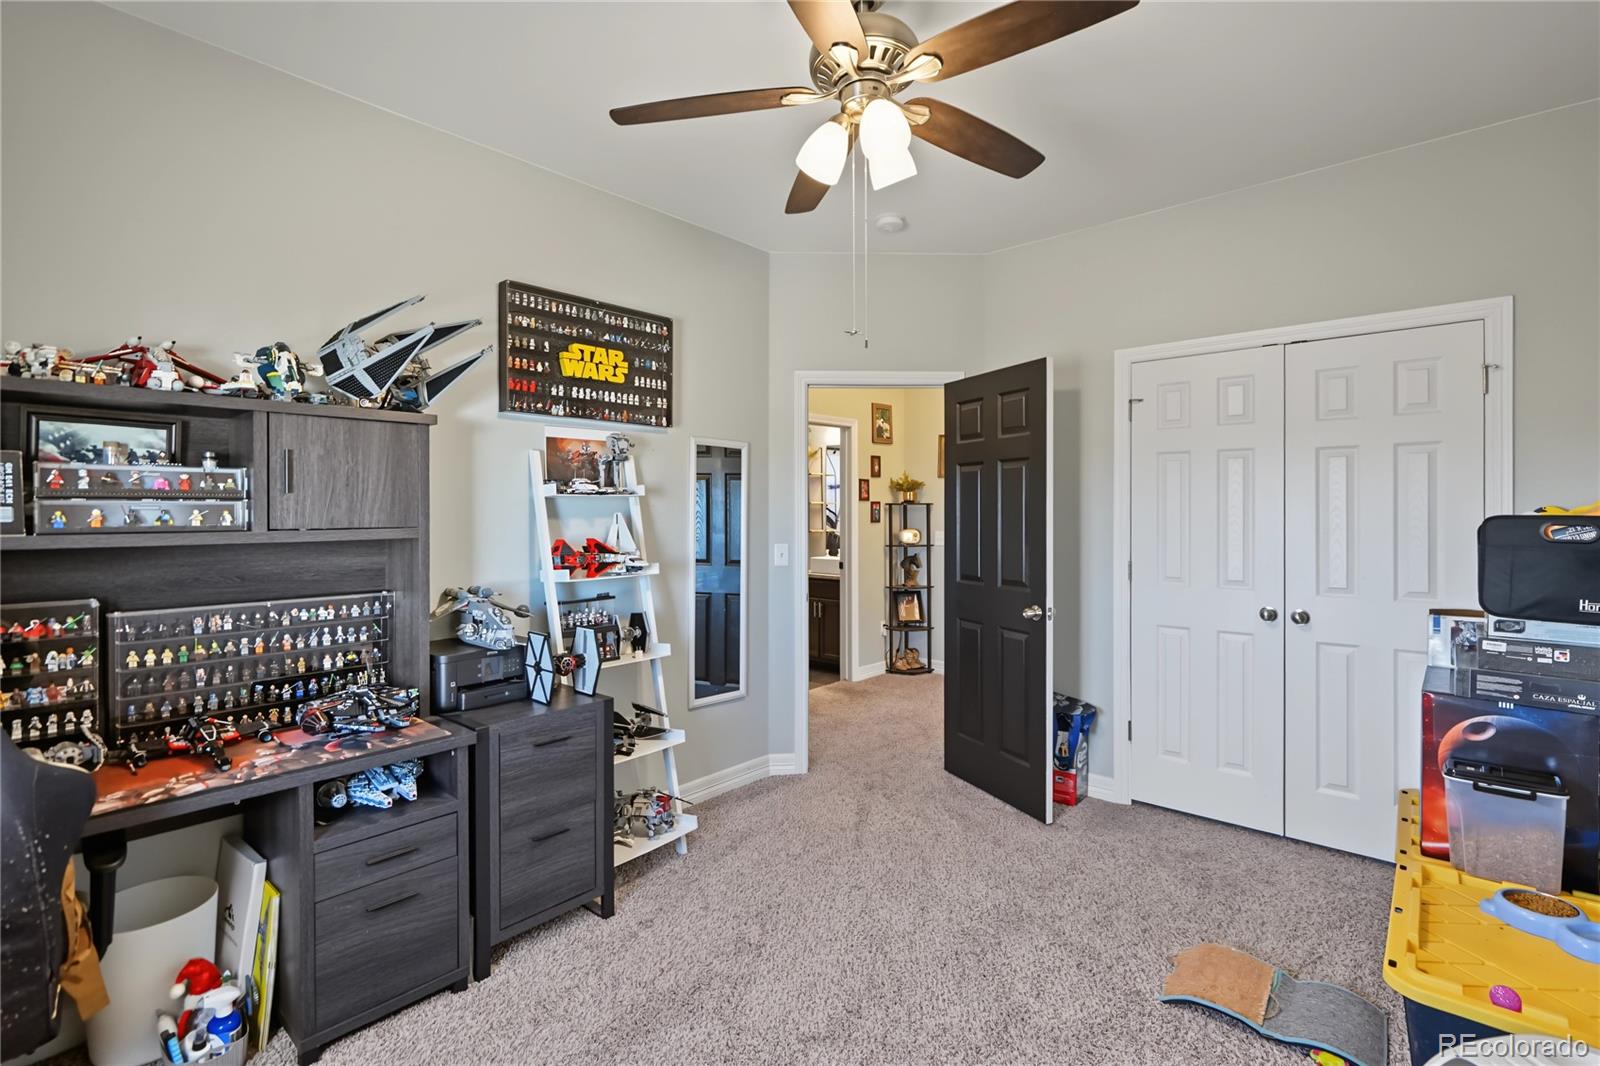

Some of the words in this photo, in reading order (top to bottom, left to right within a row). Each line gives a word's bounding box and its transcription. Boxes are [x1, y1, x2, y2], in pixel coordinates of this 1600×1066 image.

[559, 343, 628, 368] STAR
[559, 358, 628, 384] WARS
[1532, 693, 1556, 702] CAZA
